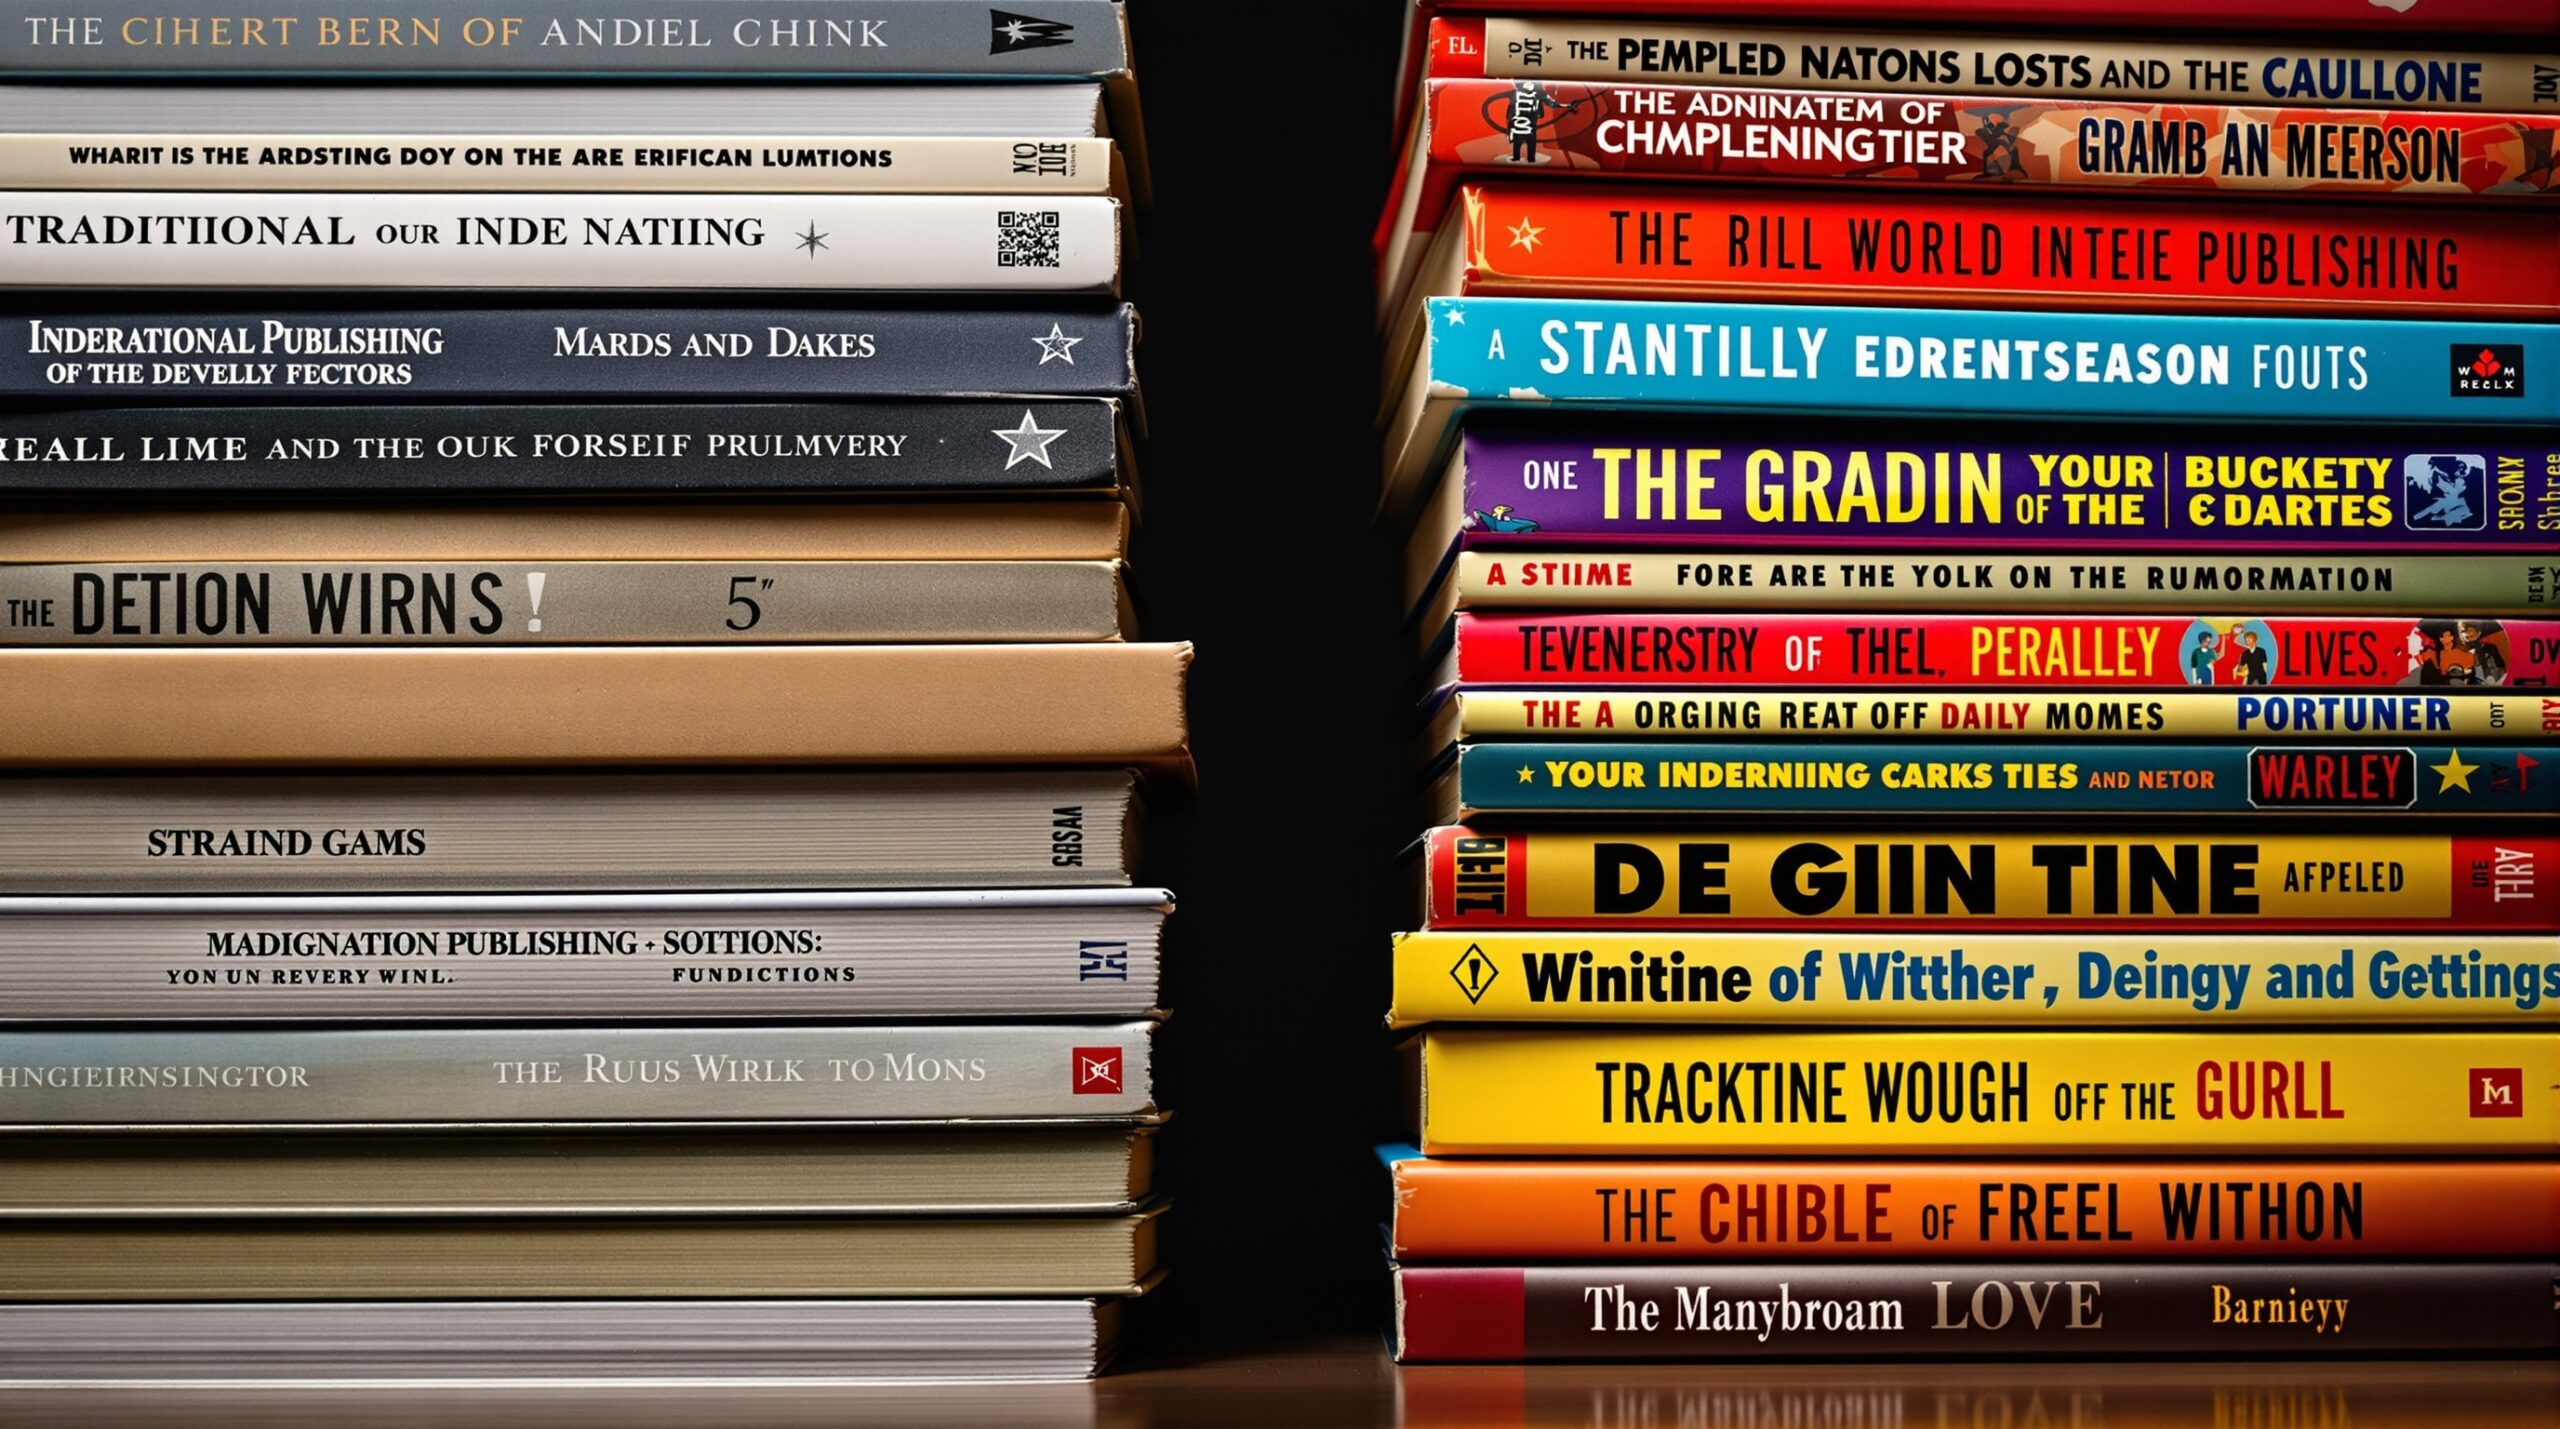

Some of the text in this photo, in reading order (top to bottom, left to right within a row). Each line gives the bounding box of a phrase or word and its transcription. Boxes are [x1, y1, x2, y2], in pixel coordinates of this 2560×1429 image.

[25, 18, 888, 46] THE CIHERT BERN OF ANDIEL CHINK
[1567, 41, 1608, 60] THE
[1618, 38, 1786, 76] PEMPLED
[1800, 45, 1961, 84] NATONS
[1975, 49, 2092, 88] LOSTS
[2100, 61, 2170, 89] AND
[2184, 61, 2249, 92] THE
[2262, 57, 2482, 102] CAULLONE
[1613, 90, 1945, 125] THE ADNINATEM OF
[69, 147, 892, 167] WHARIT IS THE ARDSTING DOY ON THE ARE ERIFICAN LUMTIONS
[2077, 117, 2458, 182] GRAMB AN MEERSON
[7, 216, 764, 246] TRADITIIONAL OUR INDE NATIING
[1610, 211, 1691, 266] THE
[1849, 219, 2001, 276] WORLD
[2033, 226, 2171, 281] INTEIE
[2199, 230, 2458, 291] PUBLISHING
[262, 320, 444, 354] PUBLISHING
[681, 334, 752, 357] AND
[1488, 320, 2367, 390] A STANTILLY EDRENTSEASON FOUTS
[2458, 367, 2470, 375] W
[47, 363, 412, 384] OF THE DEVELLY FECTORS
[2461, 380, 2514, 389] RECLX
[141, 437, 247, 461] LIME
[265, 439, 339, 459] AND
[353, 438, 424, 458] THE
[437, 436, 517, 457] OUK
[533, 434, 691, 457] FORSEIF
[708, 435, 907, 456] PRULMVERY
[1524, 449, 2001, 523] ONE THE GRADIN
[2029, 455, 2153, 487] YOUR
[2186, 456, 2392, 489] BUCKETY
[2016, 494, 2144, 525] OF THE
[2225, 494, 2392, 527] DARTES
[1487, 563, 1631, 586] A STIIME
[1678, 564, 2392, 591] FORE ARE THE YOLK ON THE RUMORMATION
[8, 600, 54, 627] THE
[73, 573, 269, 635] DETION
[303, 573, 502, 634] WIRNS
[1519, 626, 1758, 672] TEVENERSTRY
[1786, 636, 1822, 671] OF
[1973, 627, 2160, 675] PERALLEY
[1523, 700, 2164, 731] THE A ORGING REAT OFF DAILY MOMES
[2237, 697, 2451, 732] PORTUNER
[1546, 761, 2214, 788] YOUR INDERNIING CARKS TIES AND NETOR
[2259, 755, 2400, 798] WARLEY
[148, 829, 425, 856] STRAIND GAMS
[1594, 842, 2259, 915] DE GIIN TINE
[2284, 862, 2403, 892] AFPELED
[207, 932, 439, 956] MADIGNATION
[448, 931, 637, 955] PUBLISHING
[664, 930, 821, 954] SOTTIONS:
[167, 970, 216, 984] YON
[227, 970, 260, 984] UN
[273, 970, 369, 984] REVERY
[673, 967, 854, 982] FUNDICTIONS
[1522, 950, 1751, 1002] Winitine
[1770, 950, 1822, 1002] of
[2079, 950, 2250, 1011] Deingy
[2266, 949, 2353, 999] and
[2370, 950, 2560, 1009] Gettings
[494, 1062, 561, 1083] THE
[829, 1059, 874, 1081] TO
[1596, 1061, 2344, 1123] TRACKTINE WOUGH OFF THE GURLL
[1596, 1182, 2364, 1244] THE CHIBLE OF FREEL WITHON
[1585, 1280, 2104, 1341] The Manybroam LOVE
[2212, 1285, 2348, 1332] Barnieyy
